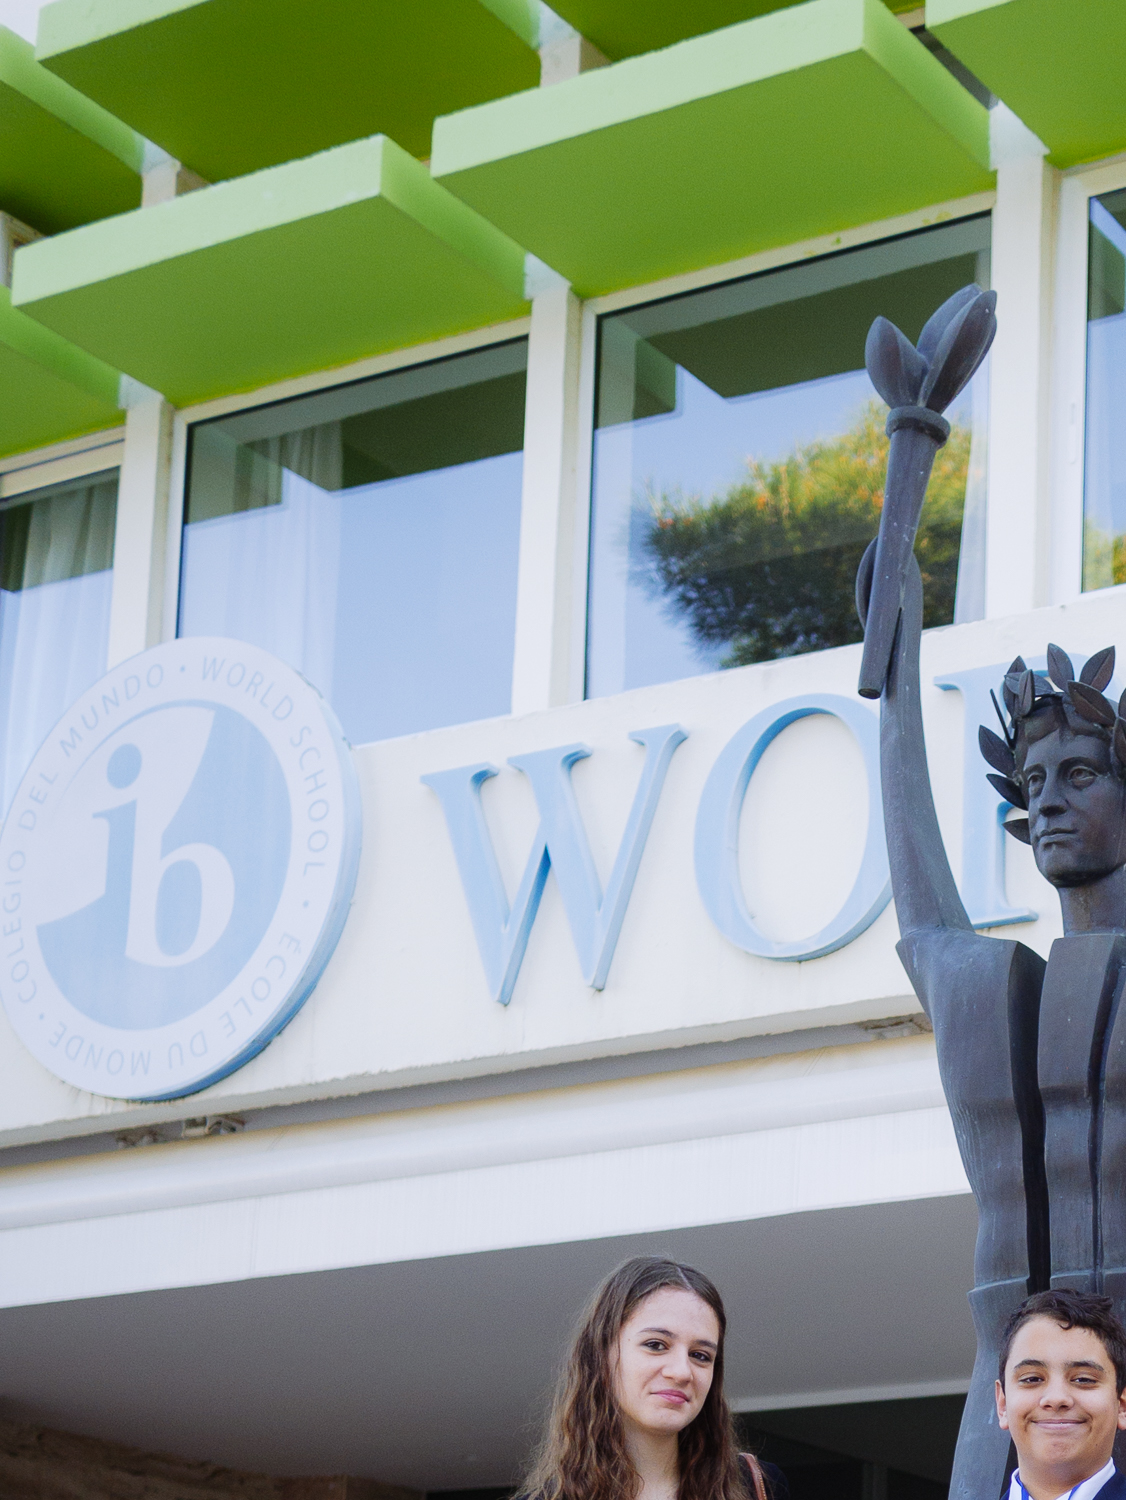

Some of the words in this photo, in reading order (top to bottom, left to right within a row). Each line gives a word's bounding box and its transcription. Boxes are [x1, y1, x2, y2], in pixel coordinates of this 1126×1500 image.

[58, 662, 166, 758] MUNDO
[17, 771, 58, 832] DEL
[200, 655, 295, 722] WORLD
[288, 725, 330, 877] SCHOOL
[92, 742, 236, 968] ib
[2, 849, 39, 1004] COLEGIO
[47, 1021, 152, 1077] MONDE
[166, 1031, 209, 1070] DU
